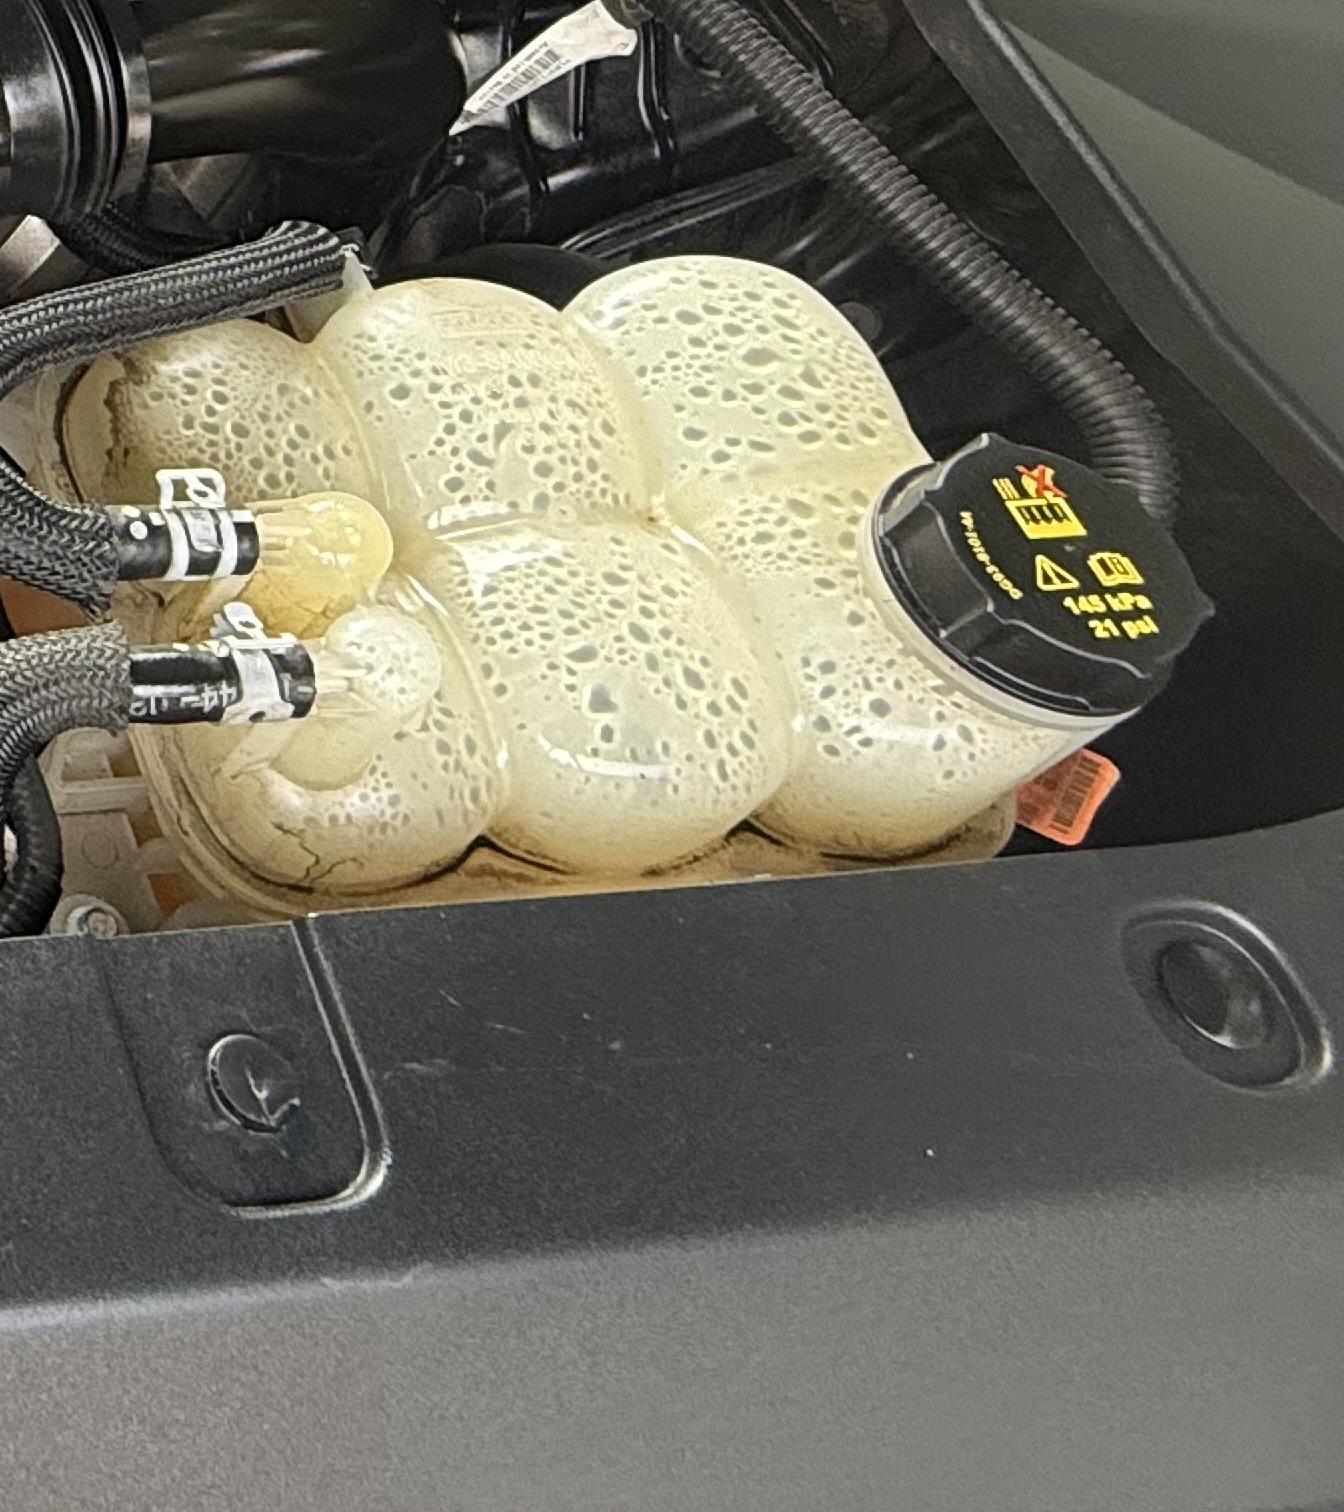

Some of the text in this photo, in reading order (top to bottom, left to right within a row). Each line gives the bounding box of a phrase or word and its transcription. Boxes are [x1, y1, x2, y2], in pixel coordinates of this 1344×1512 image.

[1062, 592, 1154, 616] 145 kPa
[1088, 614, 1160, 640] 21 psi
